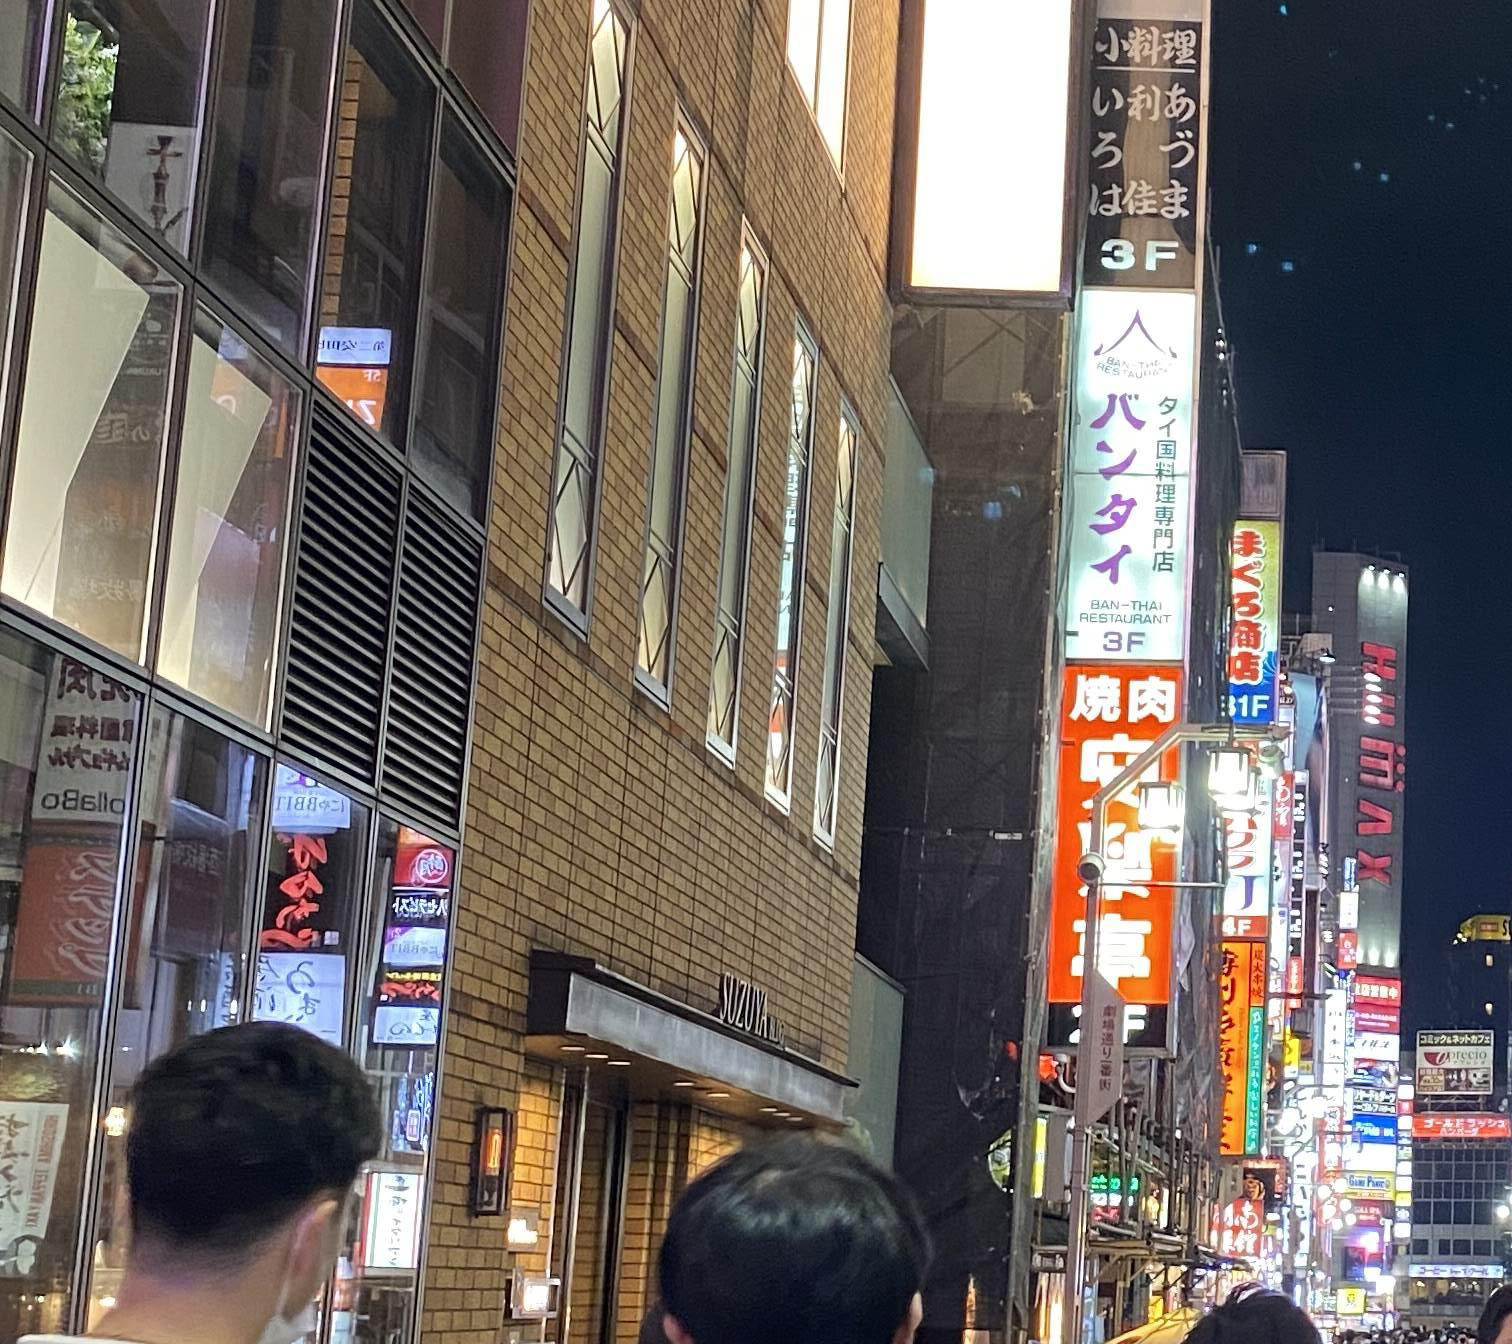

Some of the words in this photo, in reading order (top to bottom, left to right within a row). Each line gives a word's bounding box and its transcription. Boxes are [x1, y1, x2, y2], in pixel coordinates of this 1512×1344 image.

[1096, 25, 1196, 66] 小料理
[1101, 239, 1179, 272] 3F
[1089, 393, 1146, 585] バンタイ
[1152, 396, 1177, 573] タイ国料理専門店
[1079, 613, 1172, 624] RESTAURANT
[1090, 599, 1163, 611] BAN-THAI
[1103, 631, 1146, 652] 3F
[1069, 674, 1175, 723] 焼肉
[1222, 919, 1251, 935] 4F
[719, 972, 769, 1039] SUZUYA
[1100, 1005, 1116, 1091] 劇場通り一番街
